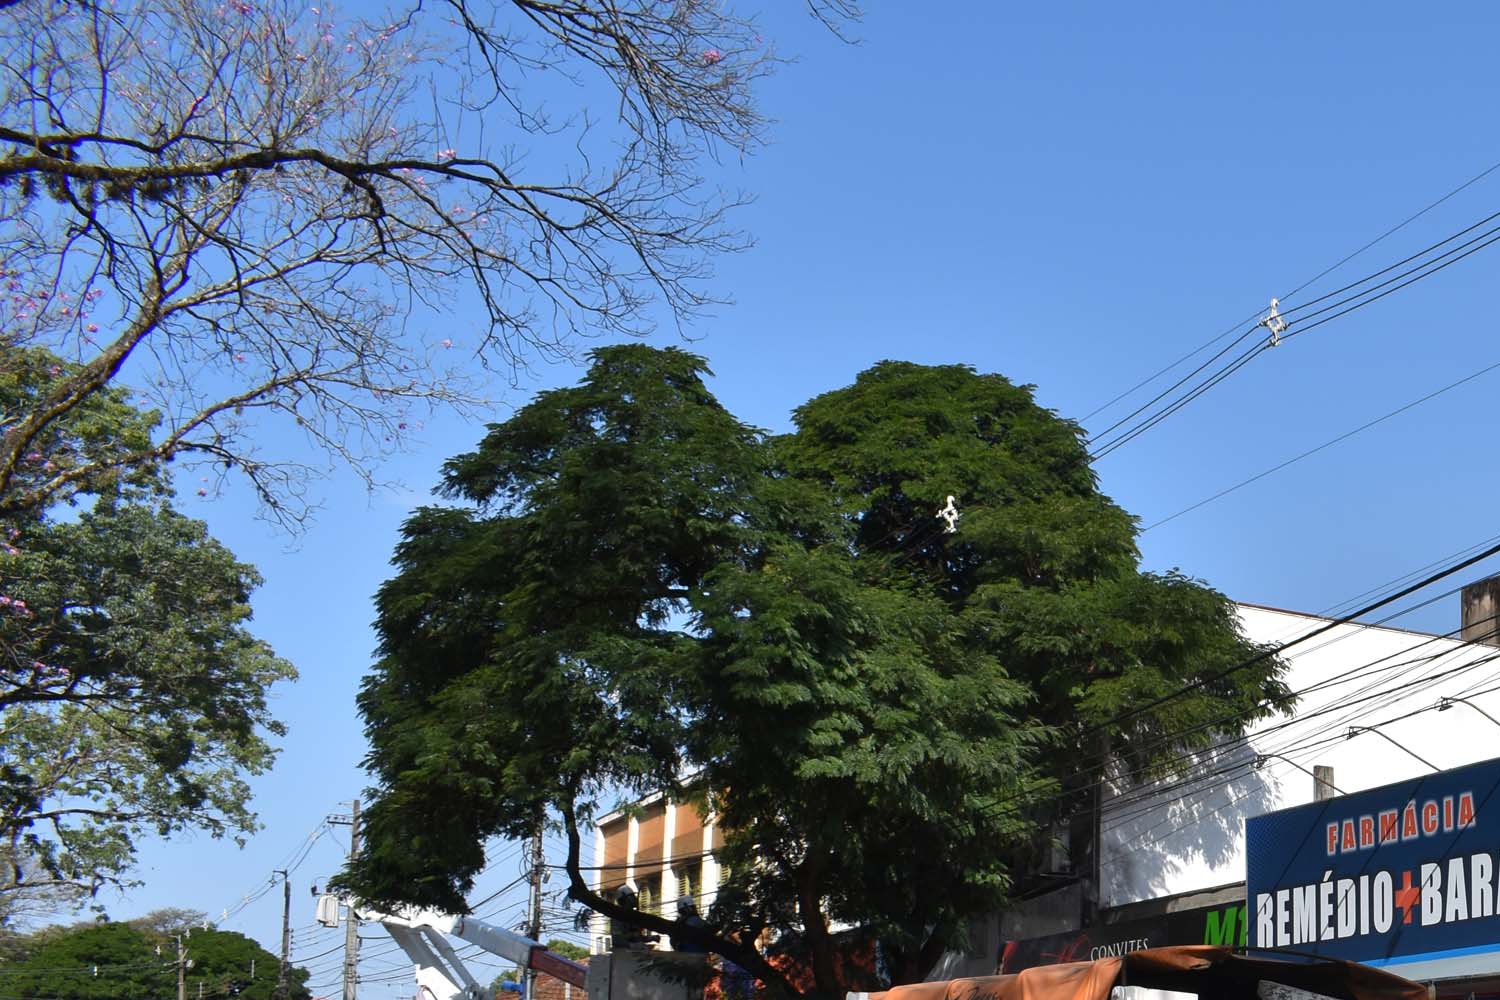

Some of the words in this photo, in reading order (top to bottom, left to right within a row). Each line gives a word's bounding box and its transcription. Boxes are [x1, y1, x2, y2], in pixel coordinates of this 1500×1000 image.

[1326, 791, 1476, 856] FARMÁCIA
[1256, 870, 1393, 949] REMÉDIO
[1090, 937, 1149, 962] CONVITES
